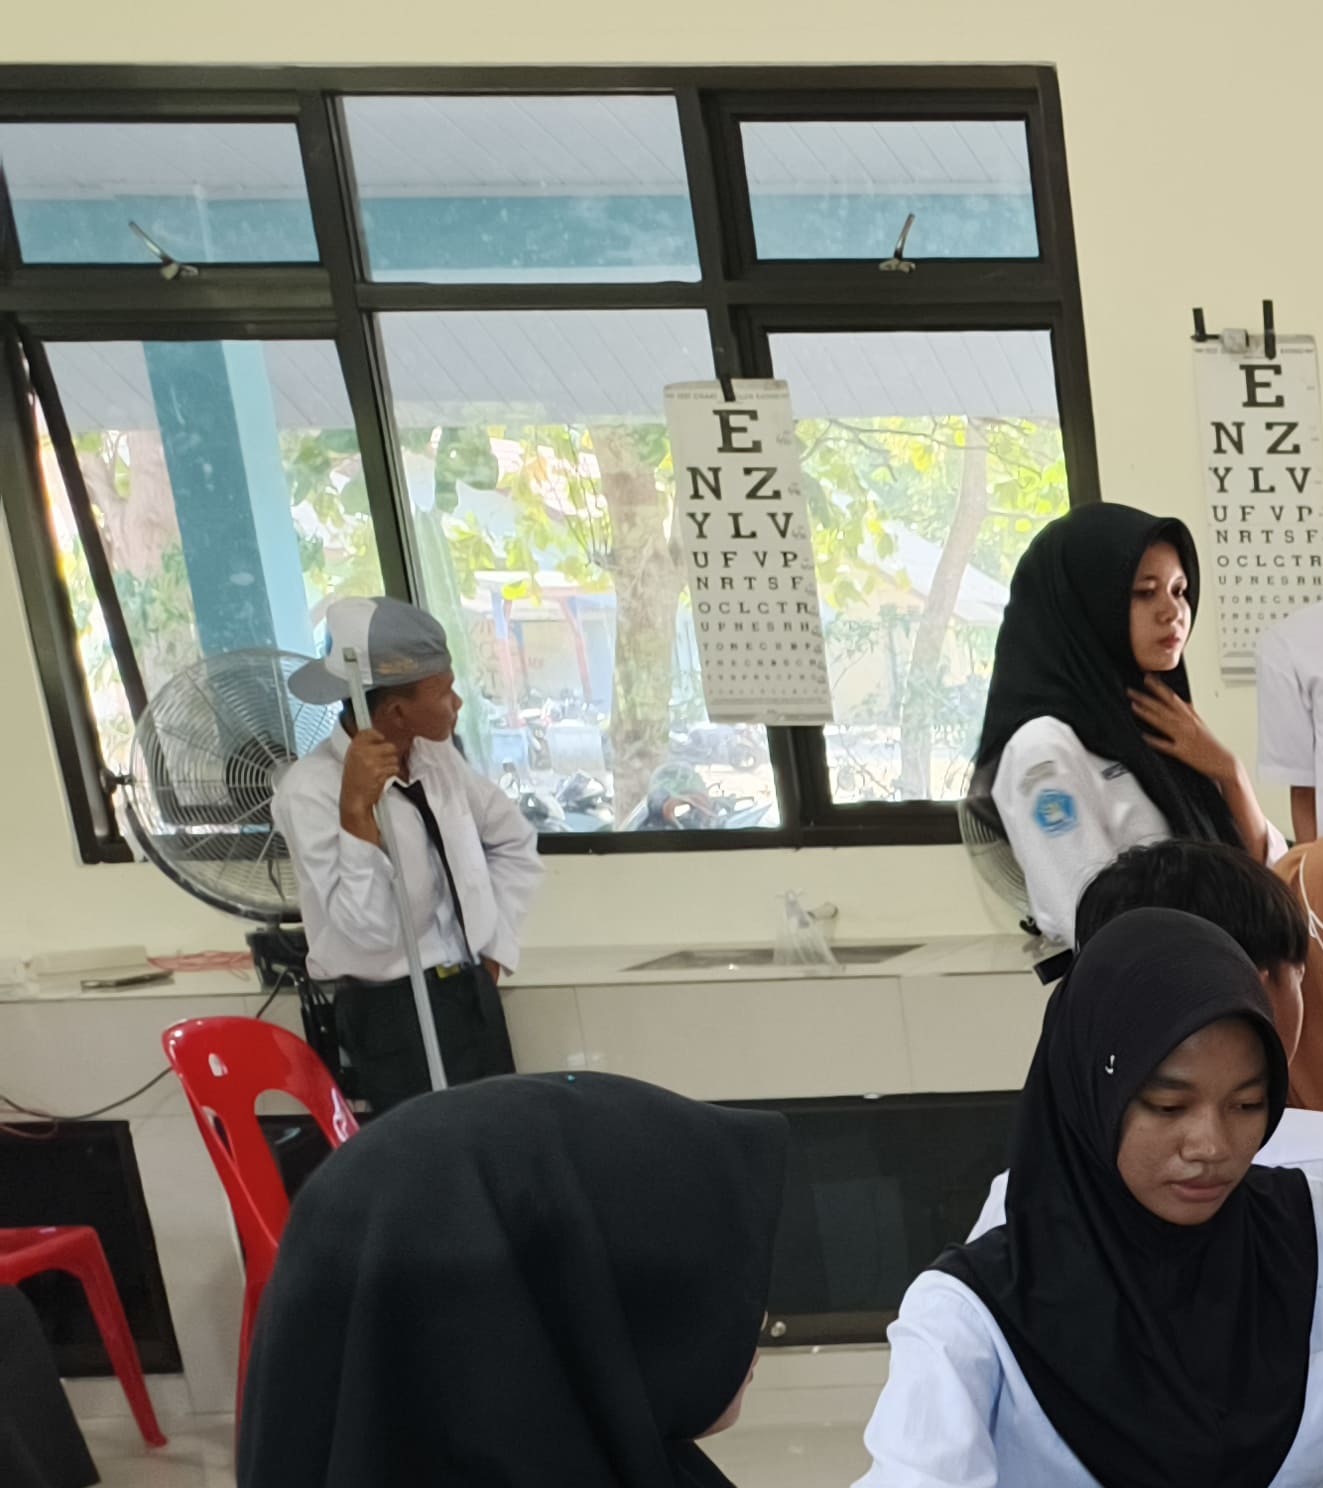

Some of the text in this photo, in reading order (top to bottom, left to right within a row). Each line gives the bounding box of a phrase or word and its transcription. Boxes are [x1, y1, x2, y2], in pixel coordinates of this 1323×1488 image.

[1239, 364, 1285, 408] E
[712, 409, 762, 453] E
[1210, 421, 1301, 455] N Z
[686, 466, 782, 500] N Z
[1210, 467, 1312, 494] Y L V
[686, 512, 794, 539] Y L V
